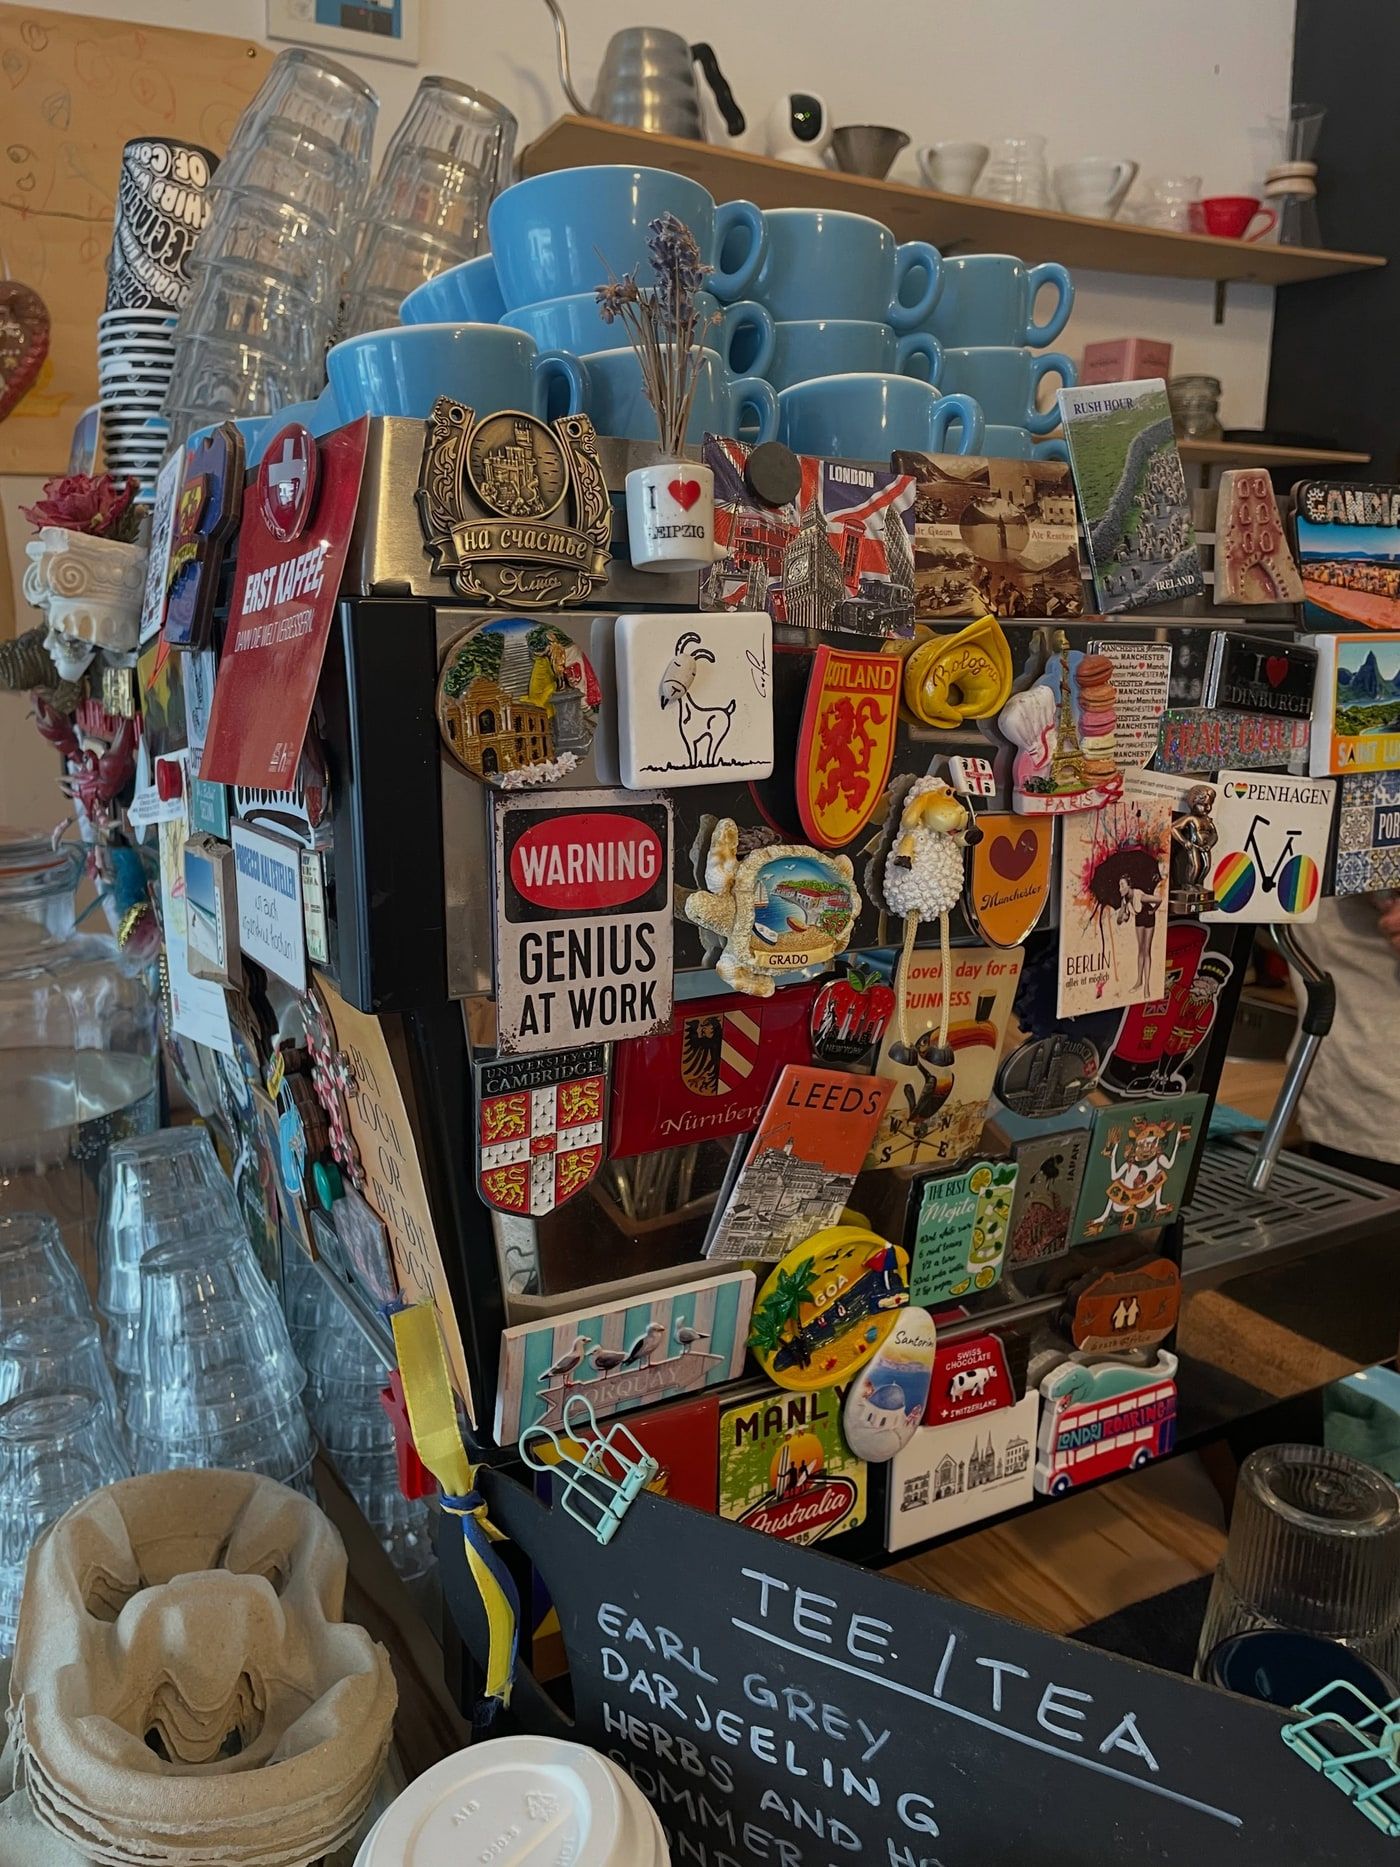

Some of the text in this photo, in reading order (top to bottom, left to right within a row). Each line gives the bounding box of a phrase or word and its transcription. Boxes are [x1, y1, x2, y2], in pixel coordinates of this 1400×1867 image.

[175, 152, 207, 189] OF
[1073, 397, 1134, 416] RUSH HOUR
[829, 463, 875, 489] LONDON
[464, 527, 587, 560] на счастье
[241, 566, 278, 616] ERST
[1155, 574, 1196, 592] IRELAND
[1120, 653, 1165, 661] MANCHESTER
[824, 660, 896, 690] COTLAND
[1118, 687, 1162, 695] MANCHESTER
[1224, 684, 1312, 714] EDINBURGH
[1043, 789, 1094, 812] PARIS
[1223, 781, 1332, 806] CPENHAGEN
[518, 839, 656, 888] WARNING
[980, 883, 1042, 911] Manchester
[518, 922, 657, 986] GENIUS
[768, 954, 809, 966] GRADO
[1066, 950, 1111, 976] BERLIN
[907, 959, 1018, 981] Lovel day for a
[518, 979, 658, 1037] AT WORK
[486, 1048, 600, 1079] UNIVERSITY OF
[486, 1060, 599, 1094] CAMBRIDGE
[786, 1080, 882, 1116] LEEDS
[660, 1101, 767, 1136] Nürnberg
[889, 1116, 903, 1133] W
[880, 1145, 892, 1164] S
[938, 1140, 949, 1158] E
[928, 1178, 967, 1201] THE BEST
[920, 1196, 976, 1226] Mojito
[394, 1236, 443, 1314] OCAL
[813, 1273, 850, 1309] GOA
[945, 1351, 992, 1371] CHOCOLATE
[956, 1347, 983, 1362] SWISS
[571, 1365, 681, 1411] ORQUAY
[735, 1382, 854, 1447] MANLY
[949, 1398, 998, 1419] SWITZERLAND
[1056, 1396, 1175, 1451] LONDON ROARING
[750, 1488, 848, 1534] Australia
[597, 1600, 892, 1764] EARL GREY
[974, 1655, 1161, 1773] TEA
[602, 1700, 735, 1795] HERBS
[759, 1788, 863, 1853] AND
